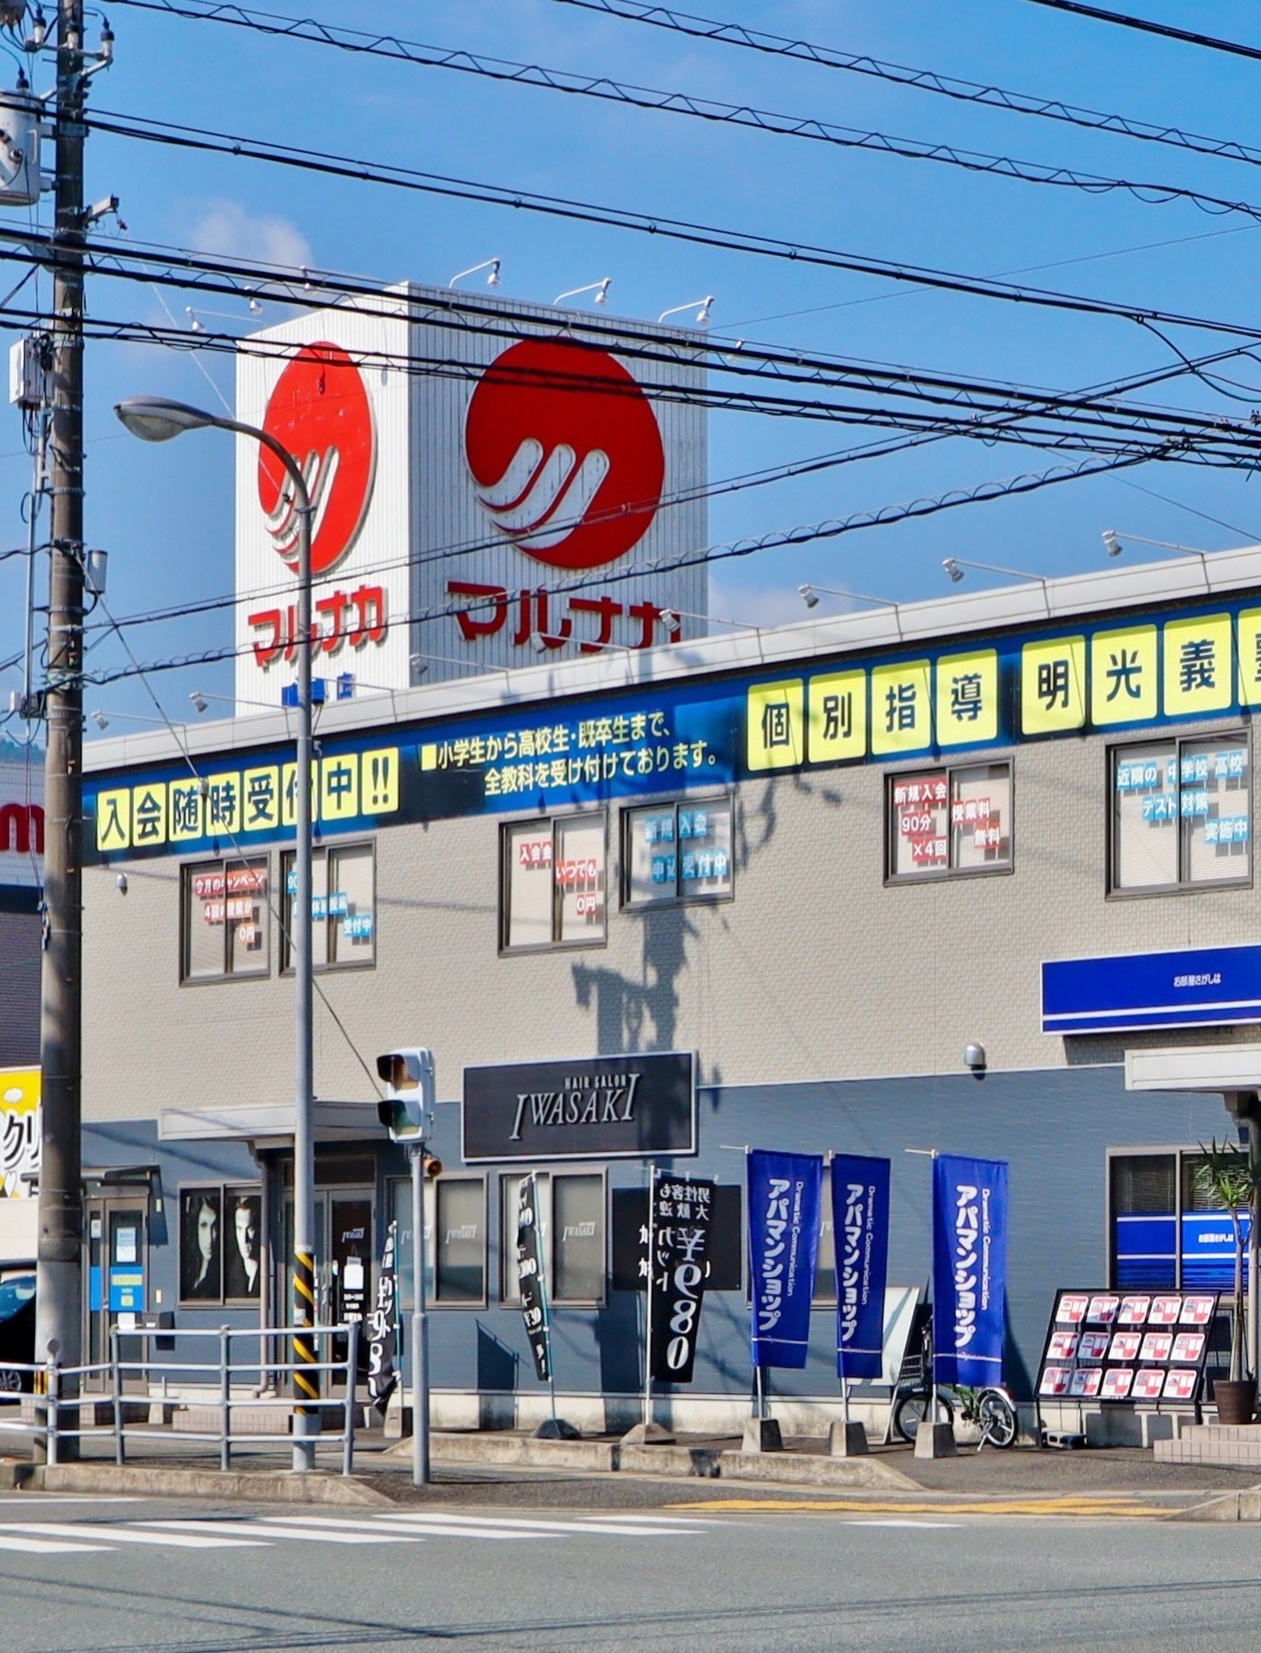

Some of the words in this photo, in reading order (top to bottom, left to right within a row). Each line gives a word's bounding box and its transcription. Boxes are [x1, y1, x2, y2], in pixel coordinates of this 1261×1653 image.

[448, 581, 681, 651] マルナカ
[761, 672, 983, 749] 個別指導
[556, 861, 597, 879] いつでも
[509, 1073, 641, 1141] IWASAKI
[564, 1076, 590, 1090] HAIR
[594, 1074, 627, 1088] SALON
[759, 1178, 790, 1331] アパマンショップ
[842, 1183, 863, 1342] アパマンショップ
[954, 1184, 978, 1348] アパマンショップ
